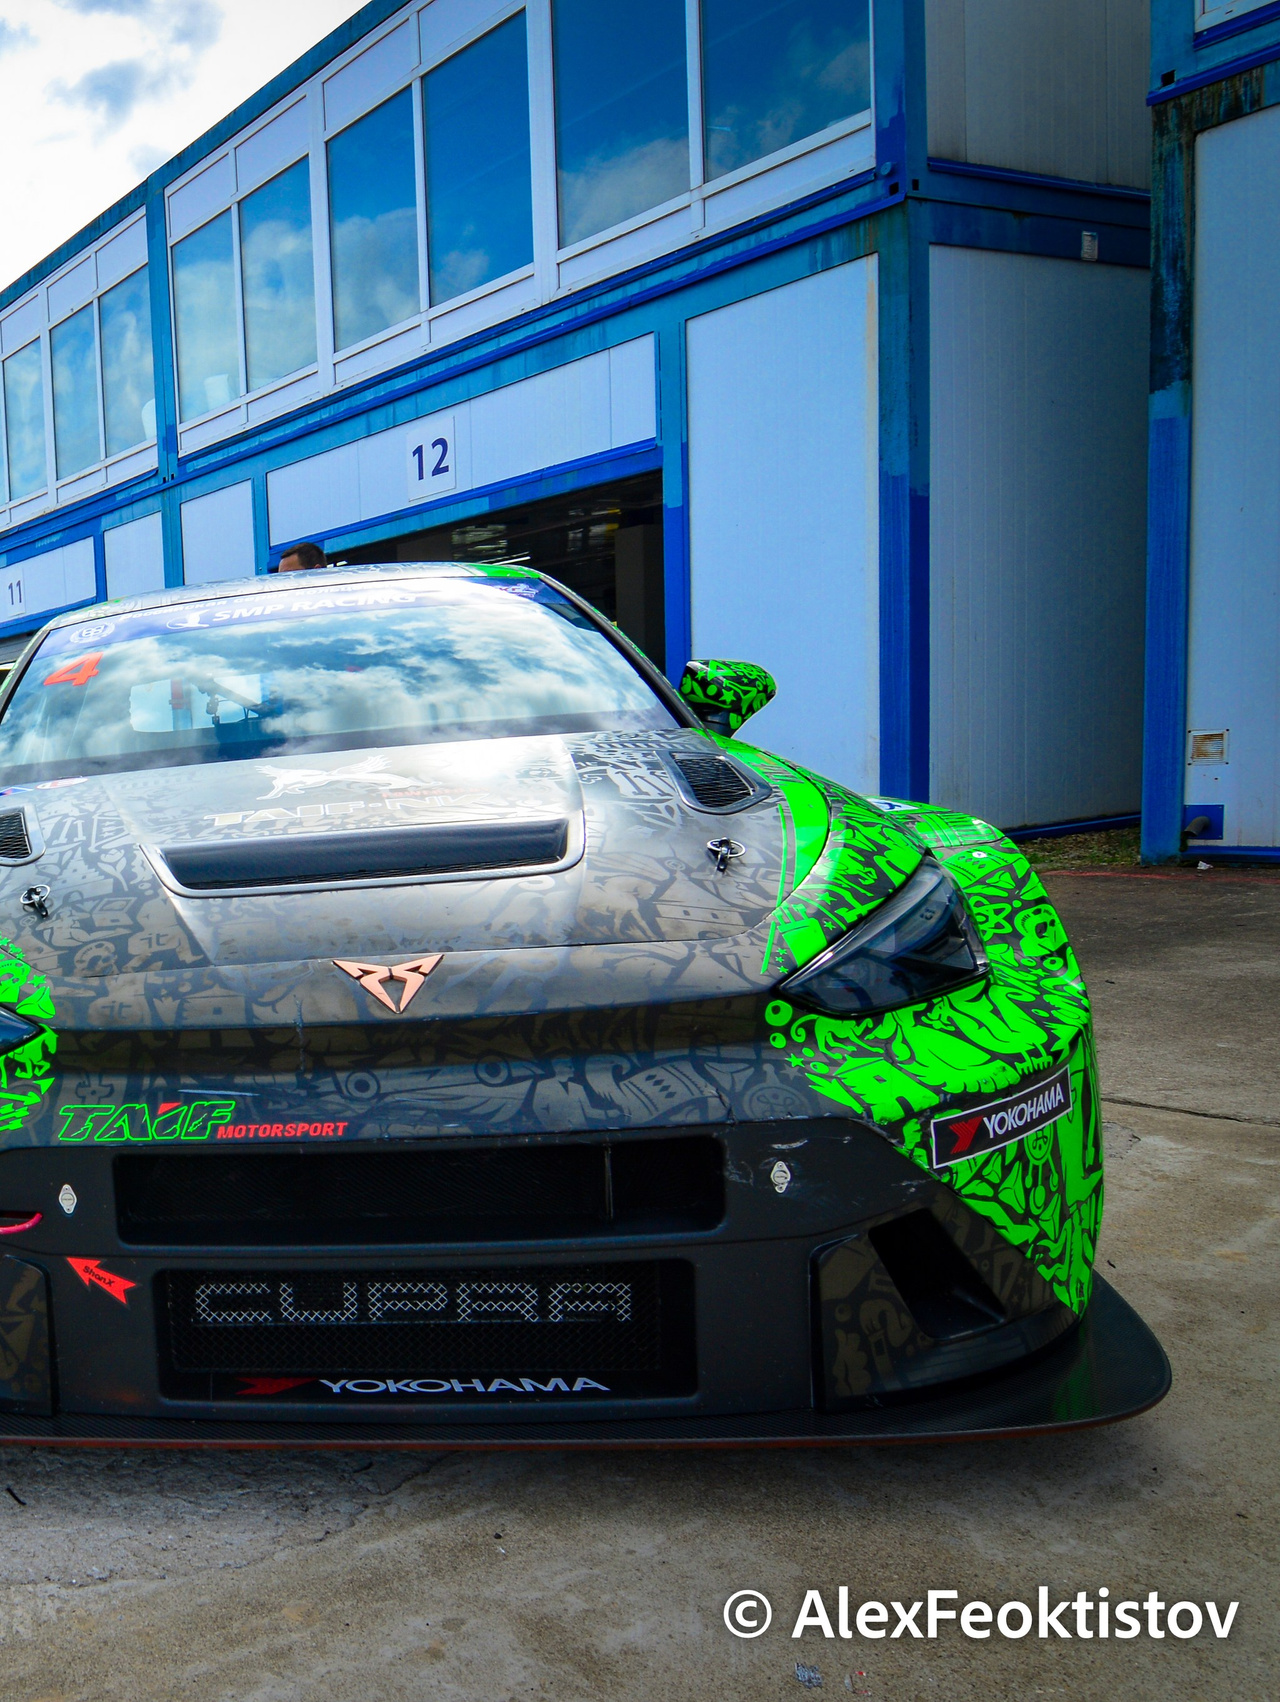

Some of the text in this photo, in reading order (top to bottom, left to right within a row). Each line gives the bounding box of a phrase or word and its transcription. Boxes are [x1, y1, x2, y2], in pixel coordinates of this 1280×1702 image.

[412, 437, 449, 481] 12
[8, 579, 22, 606] 11
[212, 592, 419, 622] SMP RACING
[43, 651, 104, 686] 4
[982, 1082, 1065, 1139] YOKOHAMA
[217, 1121, 348, 1140] MOTORSPORT
[195, 1281, 631, 1323] CUPRA
[319, 1376, 611, 1394] YOKOHAMA
